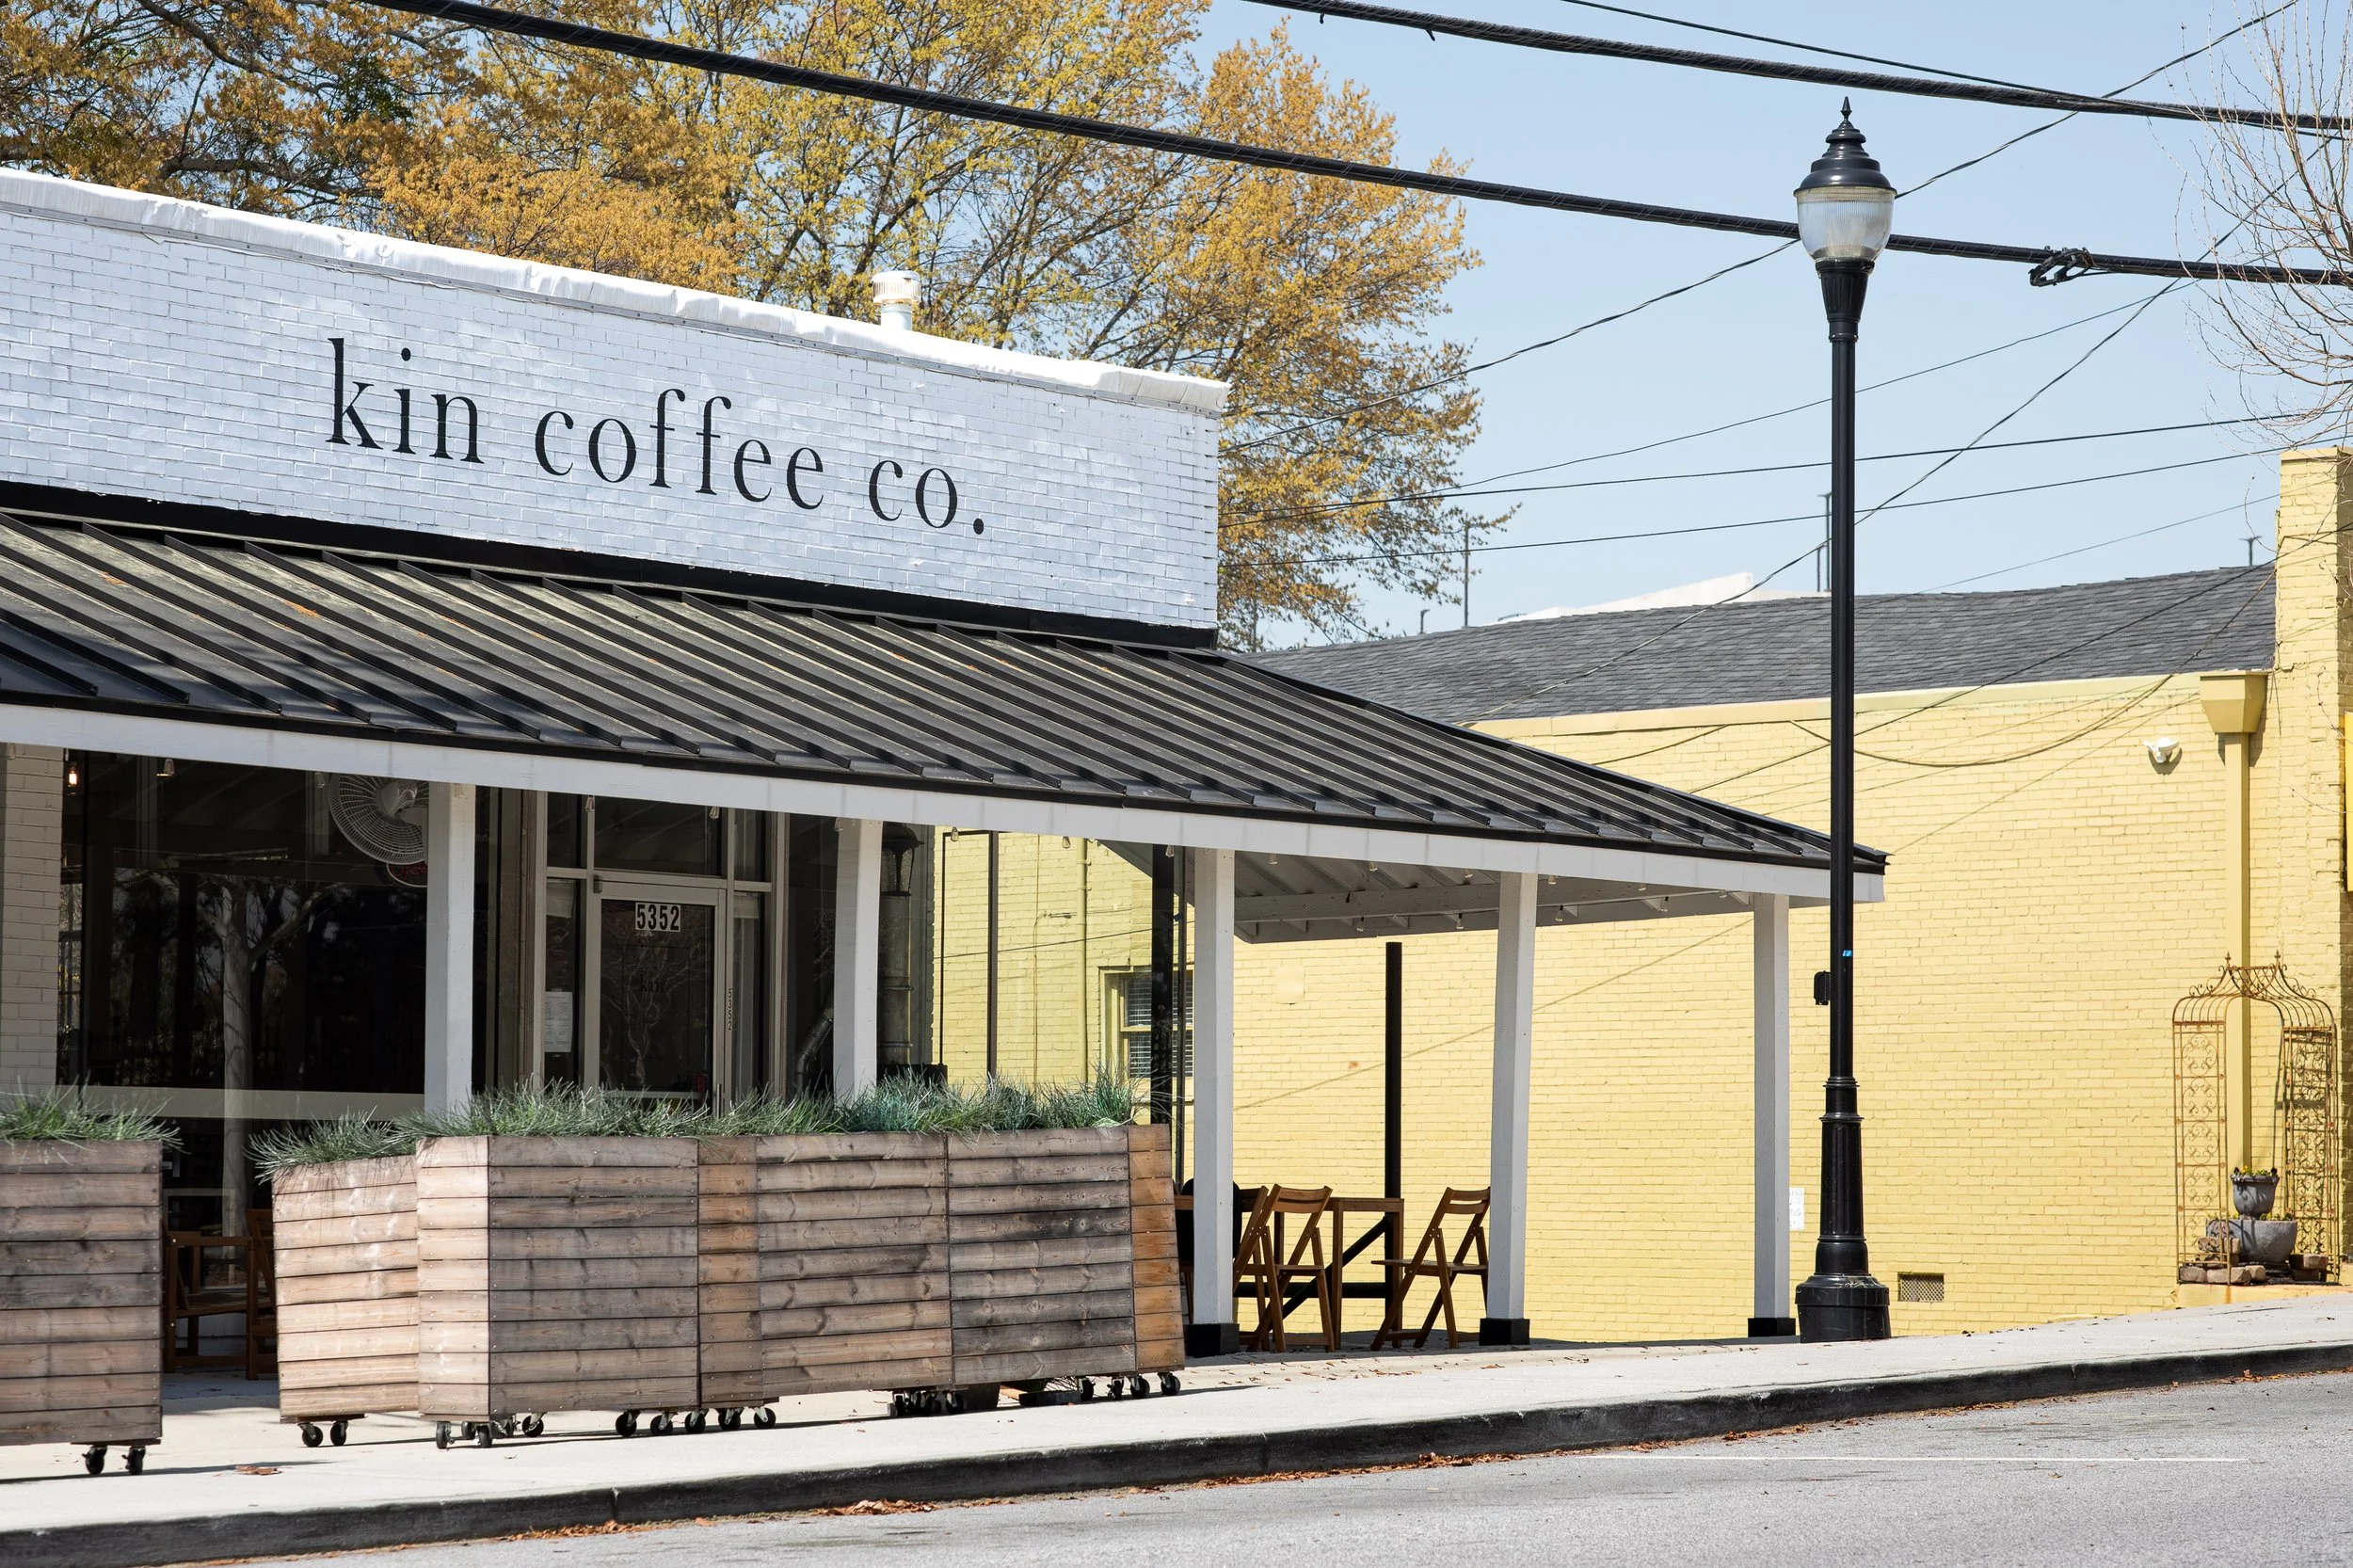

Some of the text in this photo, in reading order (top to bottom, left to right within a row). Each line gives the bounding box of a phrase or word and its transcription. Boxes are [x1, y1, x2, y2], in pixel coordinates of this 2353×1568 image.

[325, 337, 985, 536] kin coffee co.
[637, 904, 680, 931] 5352
